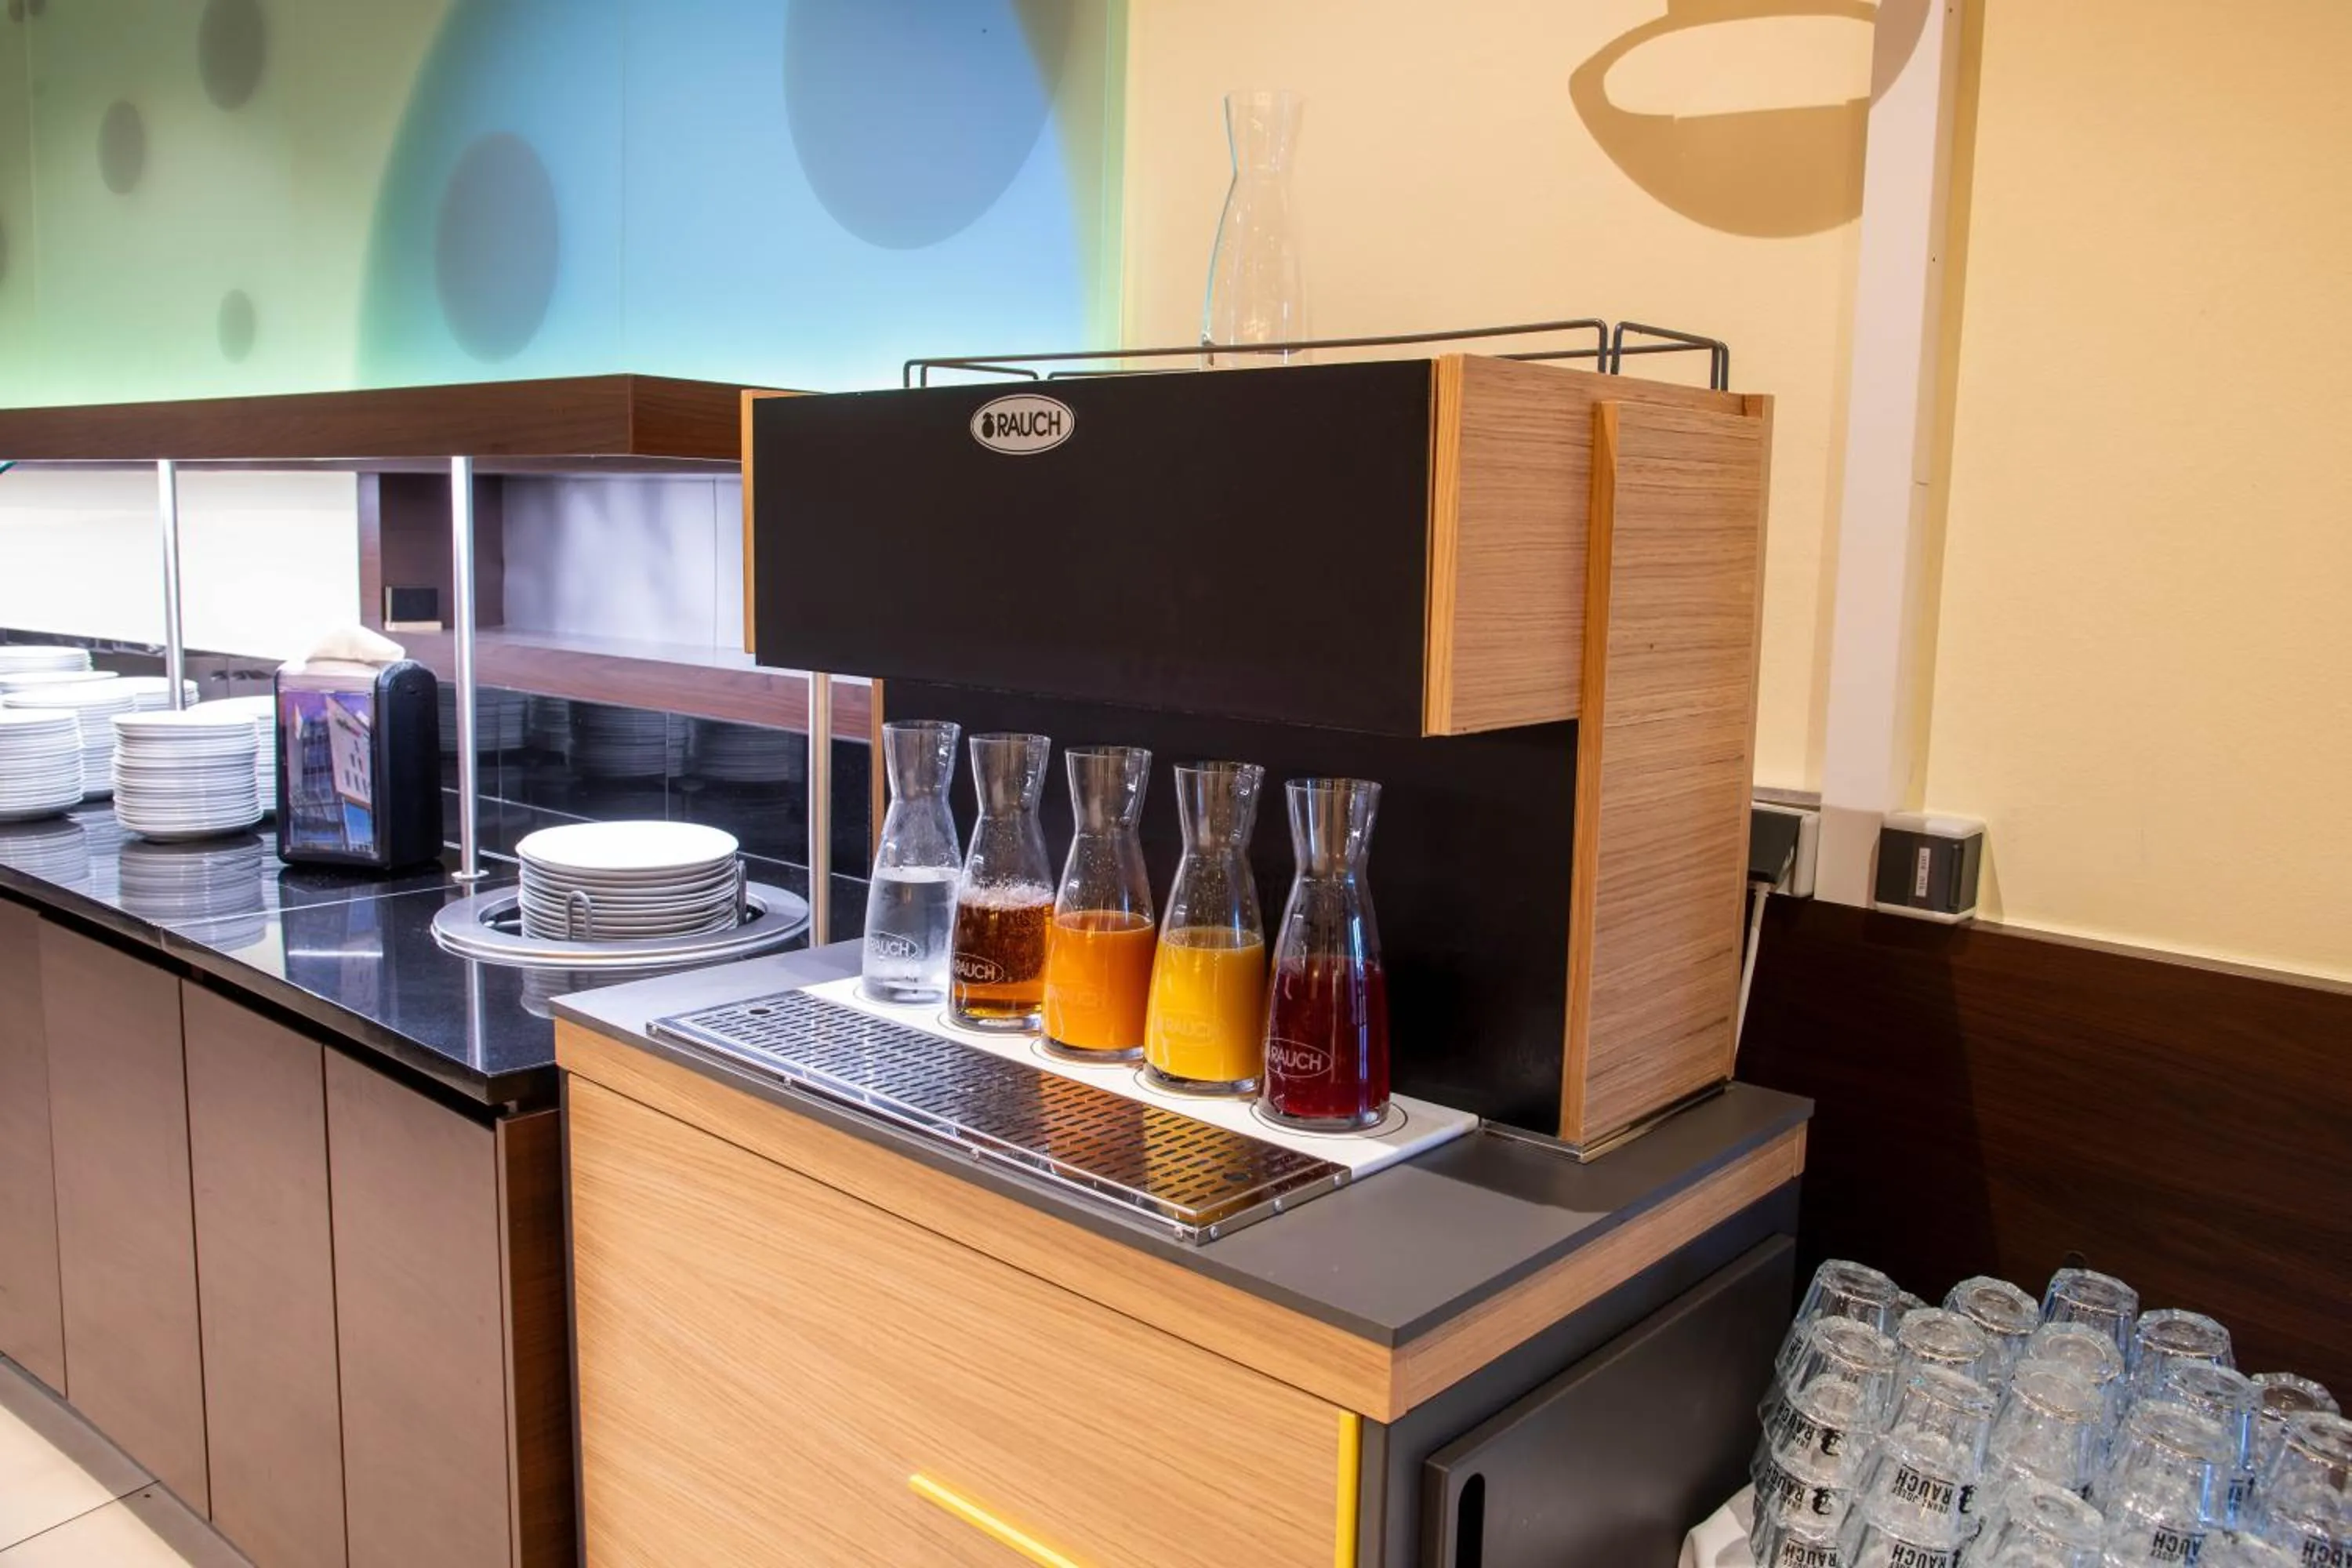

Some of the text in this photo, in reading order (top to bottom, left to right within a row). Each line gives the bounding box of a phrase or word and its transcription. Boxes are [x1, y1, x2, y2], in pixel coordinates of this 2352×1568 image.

[997, 411, 1061, 437] RAUCH
[955, 959, 995, 980] RAUCH
[1270, 1045, 1322, 1071] RAUCH
[1896, 1468, 1952, 1504] RAUCH
[1785, 1543, 1836, 1567] RAUCH
[2153, 1530, 2201, 1556] AUCH
